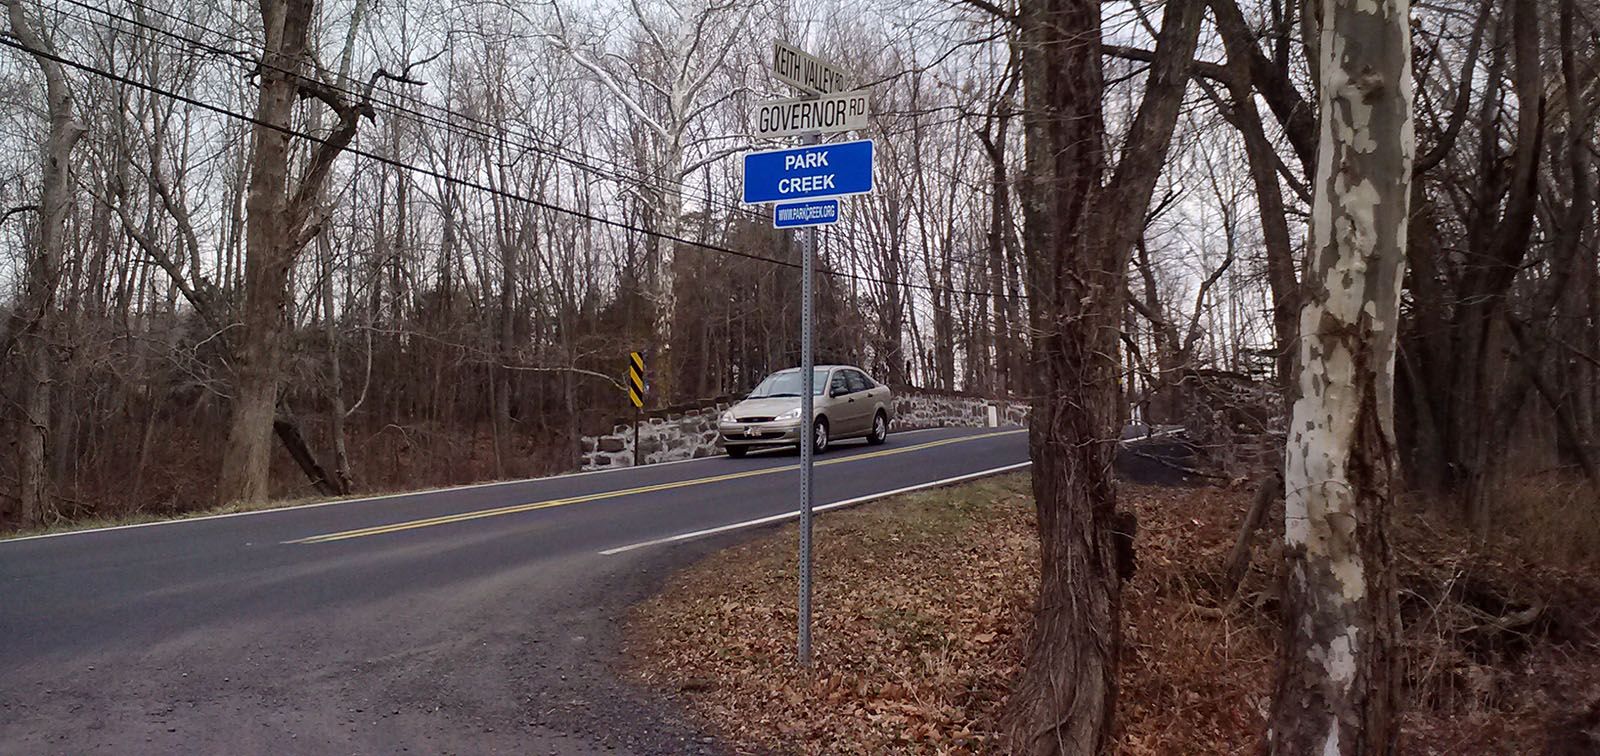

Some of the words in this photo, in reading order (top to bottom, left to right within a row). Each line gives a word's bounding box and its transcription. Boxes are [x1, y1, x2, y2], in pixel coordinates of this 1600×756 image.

[774, 44, 801, 82] KEITH
[804, 57, 835, 94] VALLEY
[835, 72, 844, 93] RD
[760, 99, 846, 133] GOVERNOR
[849, 97, 865, 116] RD
[785, 151, 829, 171] PARK
[778, 174, 835, 194] CREEK
